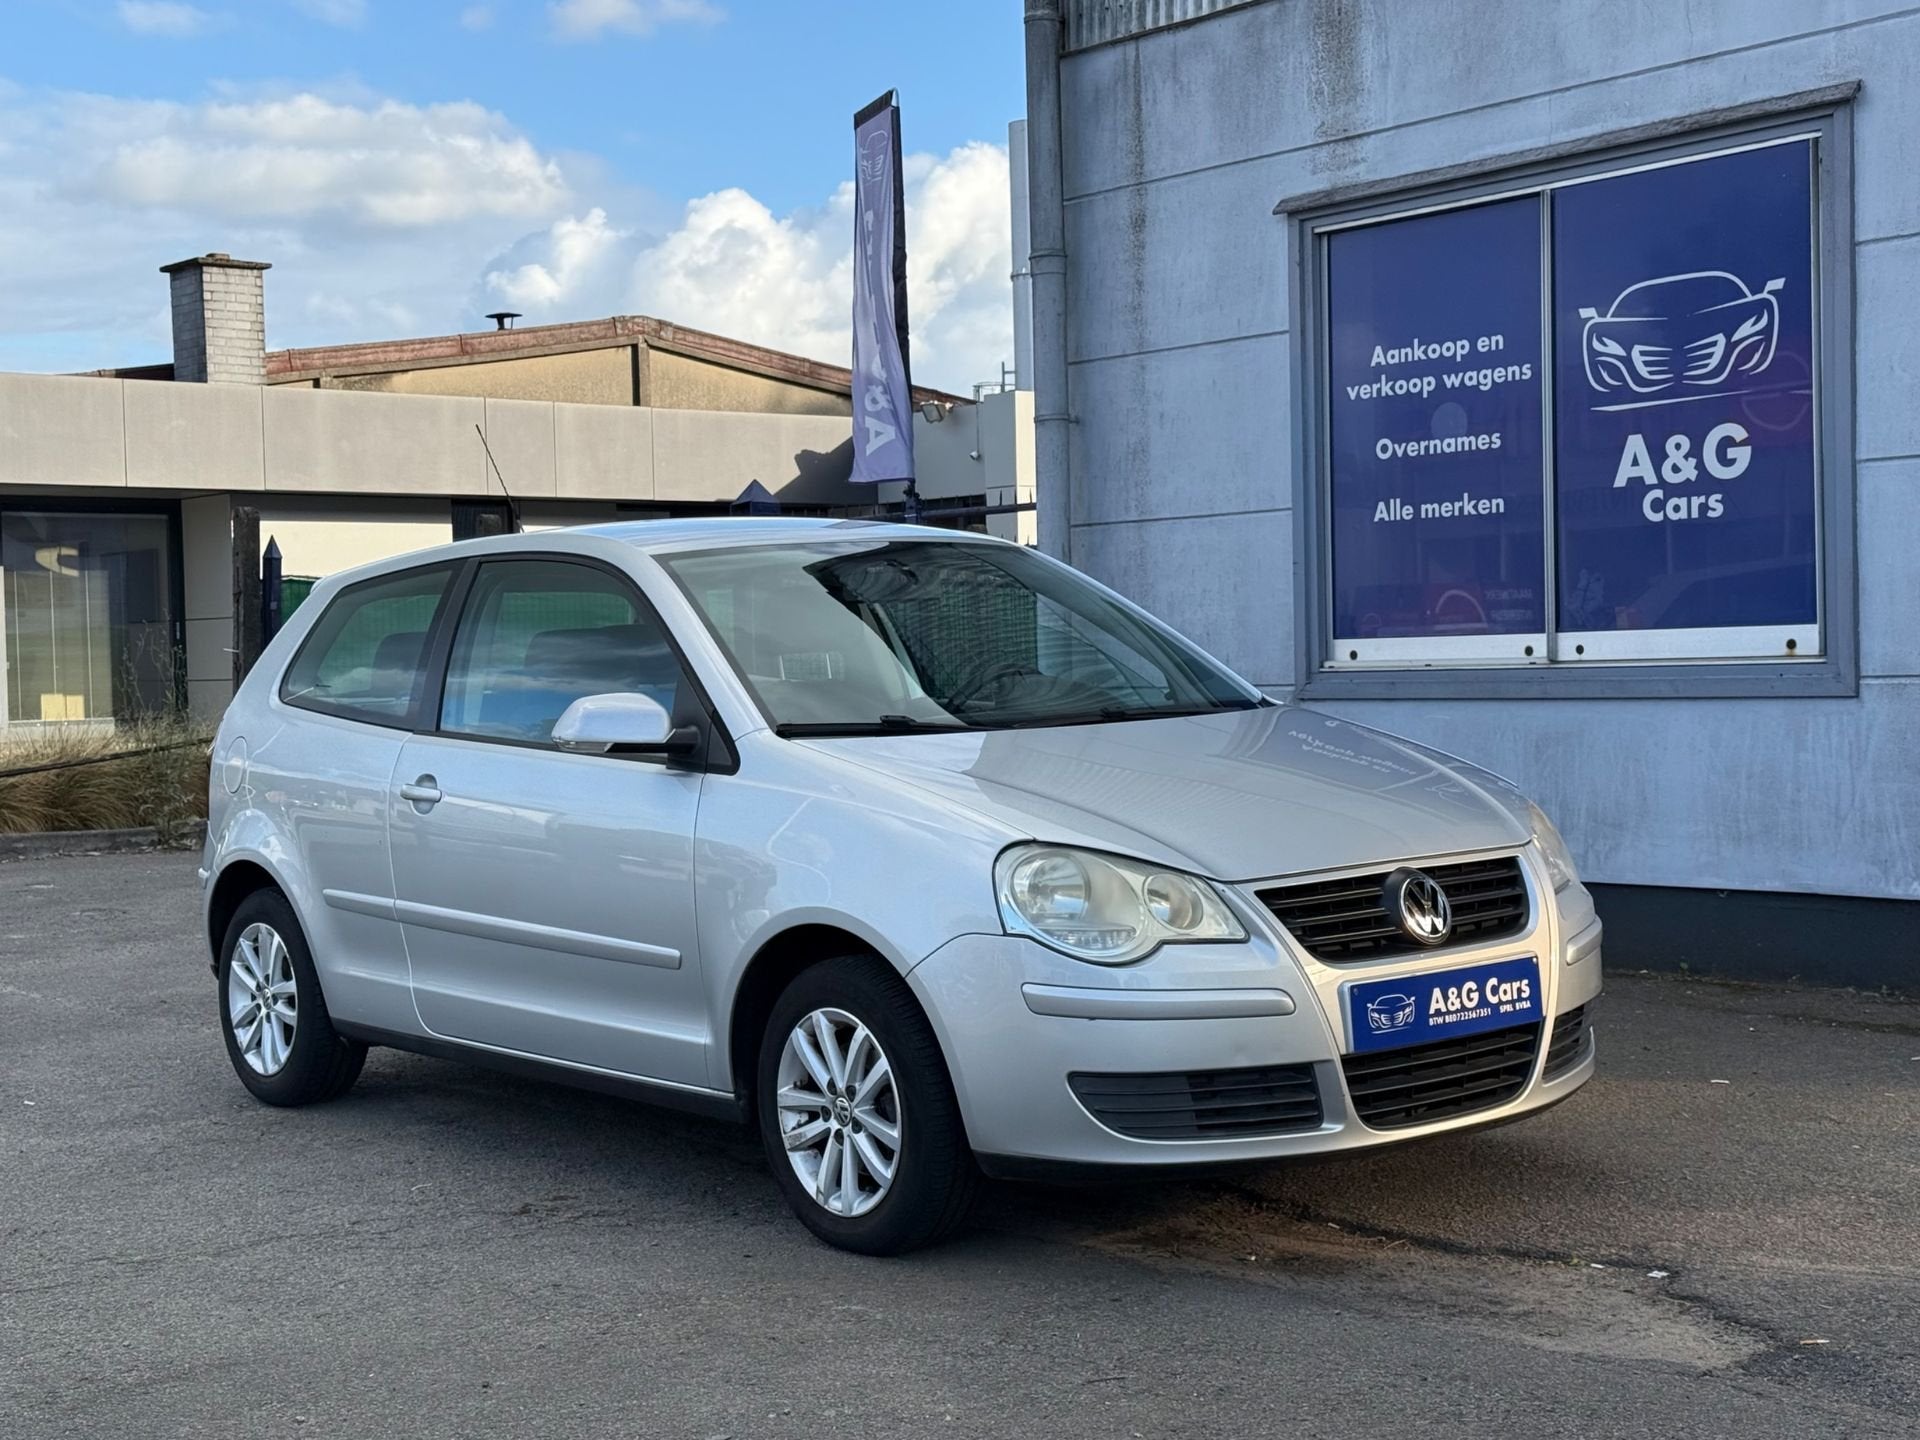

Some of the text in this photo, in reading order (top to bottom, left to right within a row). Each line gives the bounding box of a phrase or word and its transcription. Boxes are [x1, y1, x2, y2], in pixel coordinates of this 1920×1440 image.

[1371, 331, 1504, 367] Aankoop en
[1347, 363, 1532, 401] verkoop wagens
[1375, 432, 1502, 460] Overnames
[1612, 422, 1752, 488] A&G
[1373, 492, 1505, 522] Alle merken
[1642, 488, 1724, 522] Cars
[1428, 977, 1531, 1014] A&G Cars
[1428, 1016, 1444, 1026] BTW
